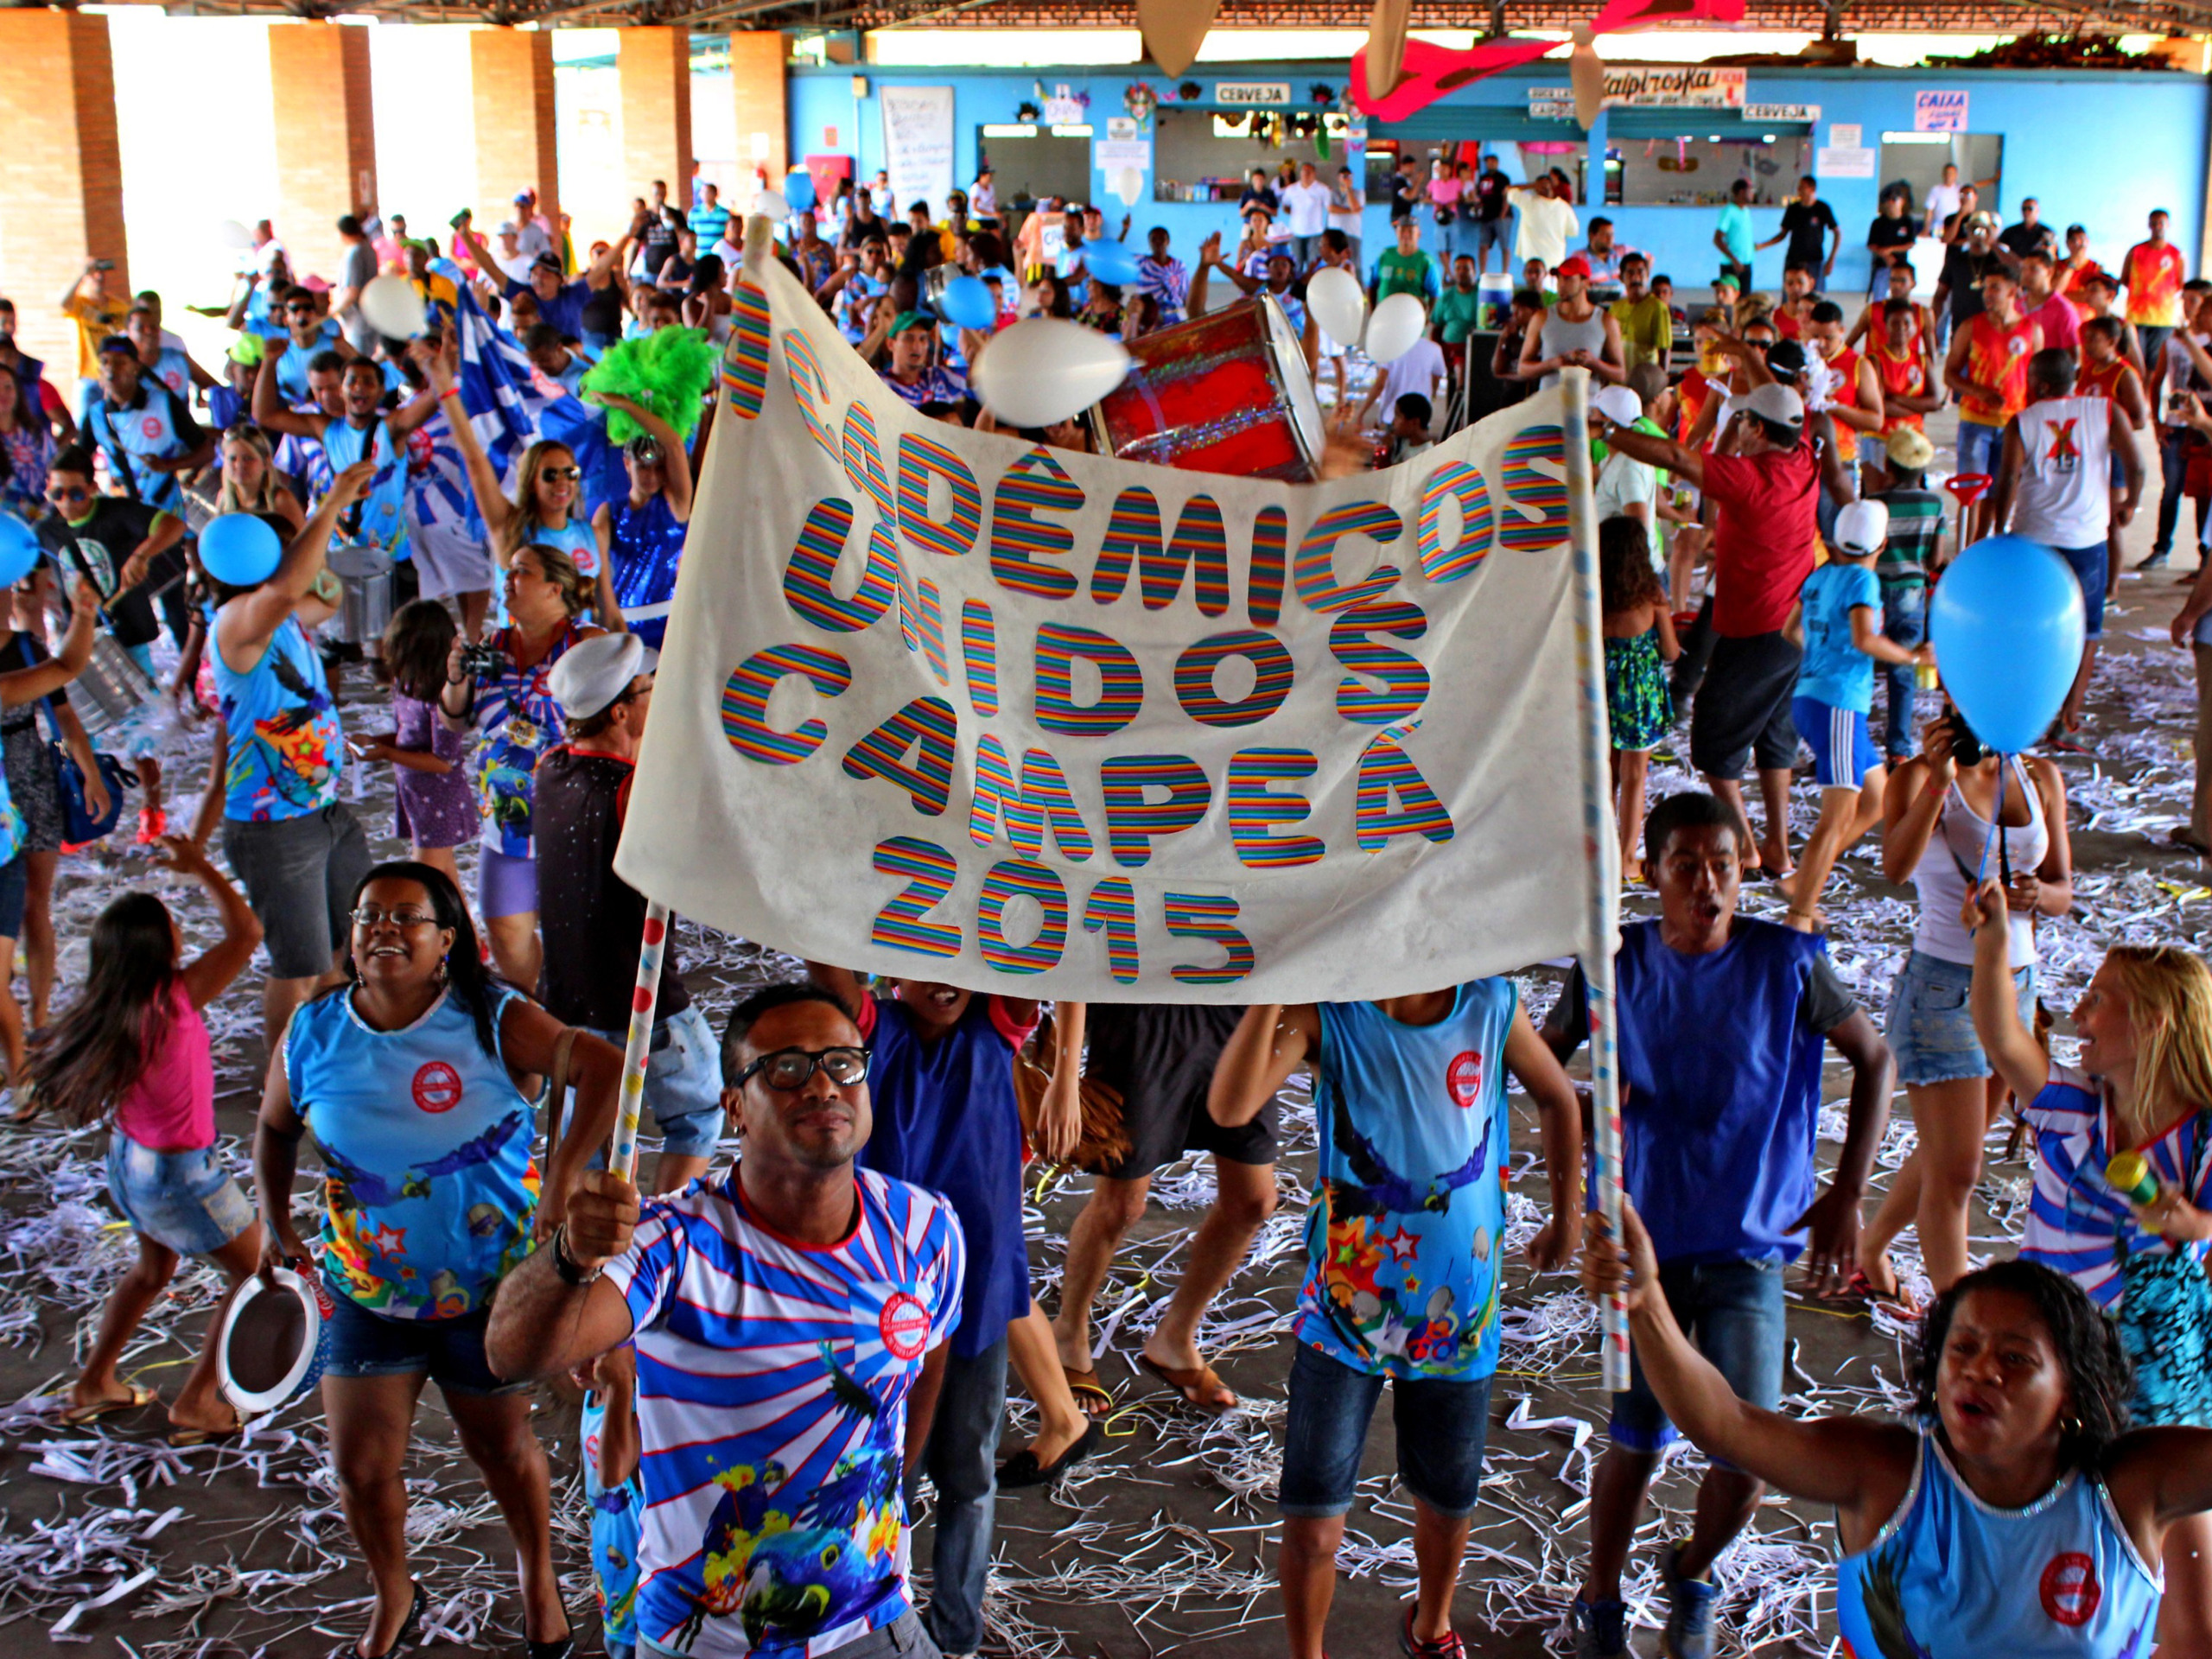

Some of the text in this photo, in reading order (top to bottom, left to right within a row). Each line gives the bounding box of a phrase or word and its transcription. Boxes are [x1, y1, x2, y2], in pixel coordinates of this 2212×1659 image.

[1219, 88, 1282, 101] CERVEJA
[1745, 105, 1808, 118] CERVEJA
[1918, 92, 1965, 108] CAIXA
[721, 280, 1570, 628] ACADÊMICOS
[783, 497, 1431, 736] UNIDOS
[871, 835, 1255, 985] 2015
